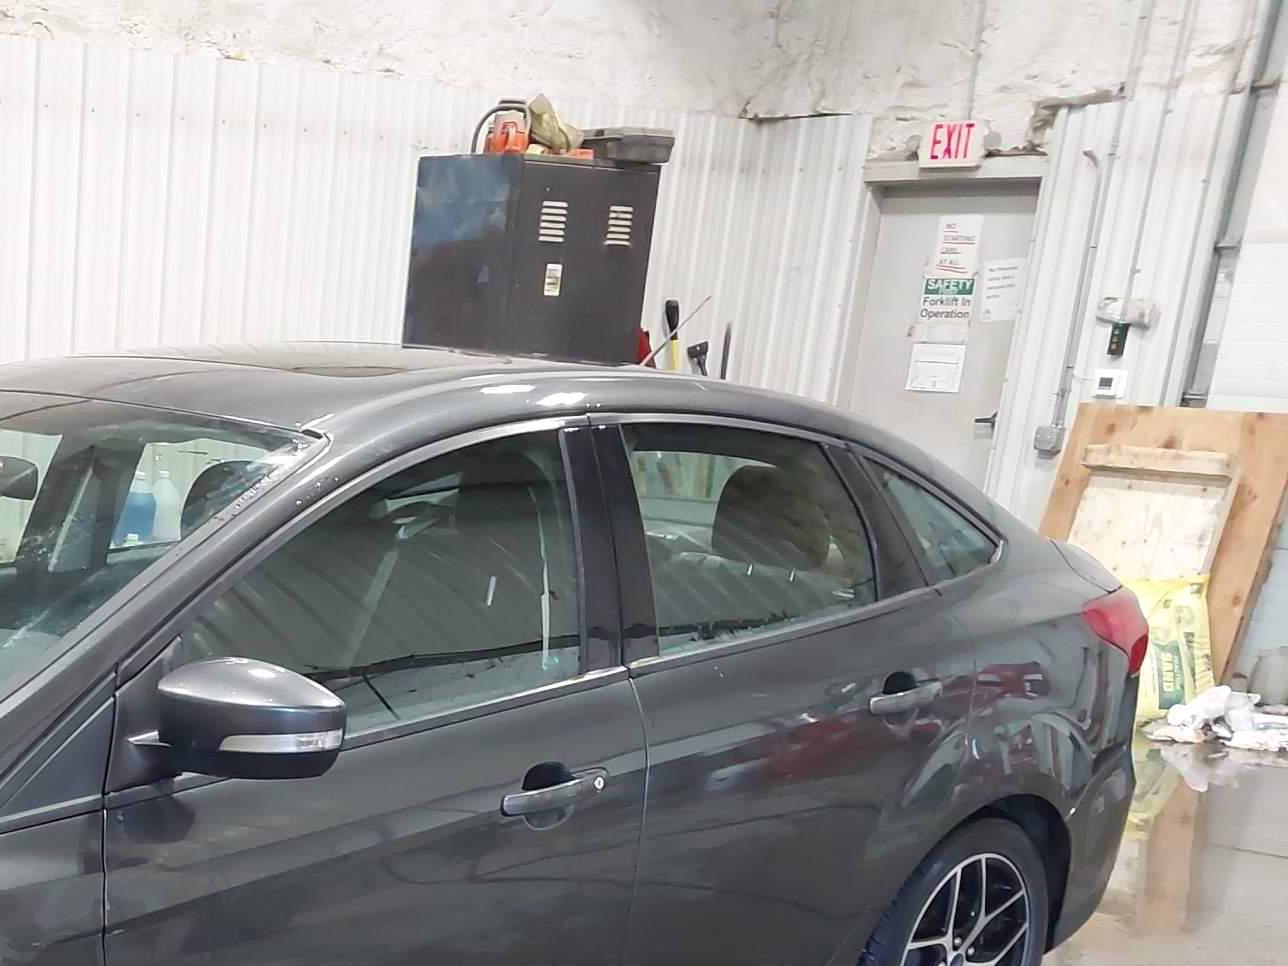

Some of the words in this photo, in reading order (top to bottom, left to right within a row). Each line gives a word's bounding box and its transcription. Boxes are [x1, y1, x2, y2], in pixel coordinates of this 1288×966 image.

[930, 123, 975, 160] EXIT
[927, 278, 974, 291] SAFETY
[922, 296, 959, 307] Forklift
[961, 296, 972, 307] In
[919, 308, 970, 320] Operation
[1161, 651, 1175, 692] SAND
